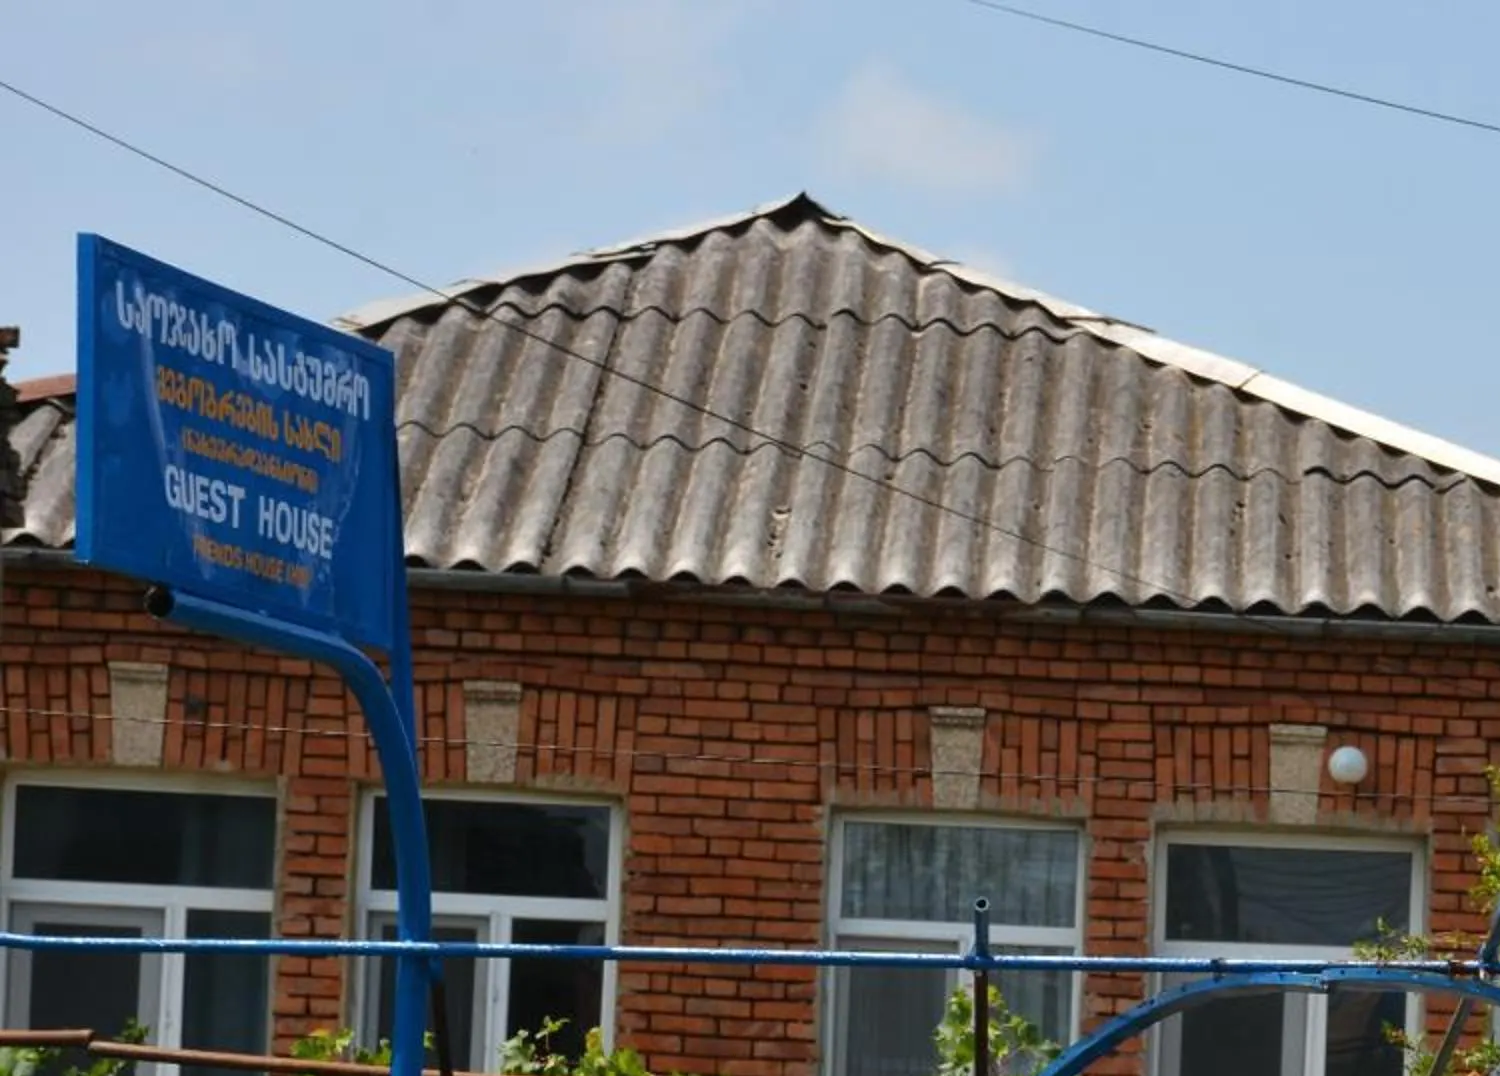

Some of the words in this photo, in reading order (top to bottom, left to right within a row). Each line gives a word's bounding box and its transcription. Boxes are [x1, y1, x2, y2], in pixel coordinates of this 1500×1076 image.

[115, 280, 239, 370] საოჯახო
[249, 333, 371, 421] სასტუმრო
[164, 464, 247, 529] GUEST
[257, 495, 334, 560] HOUSE
